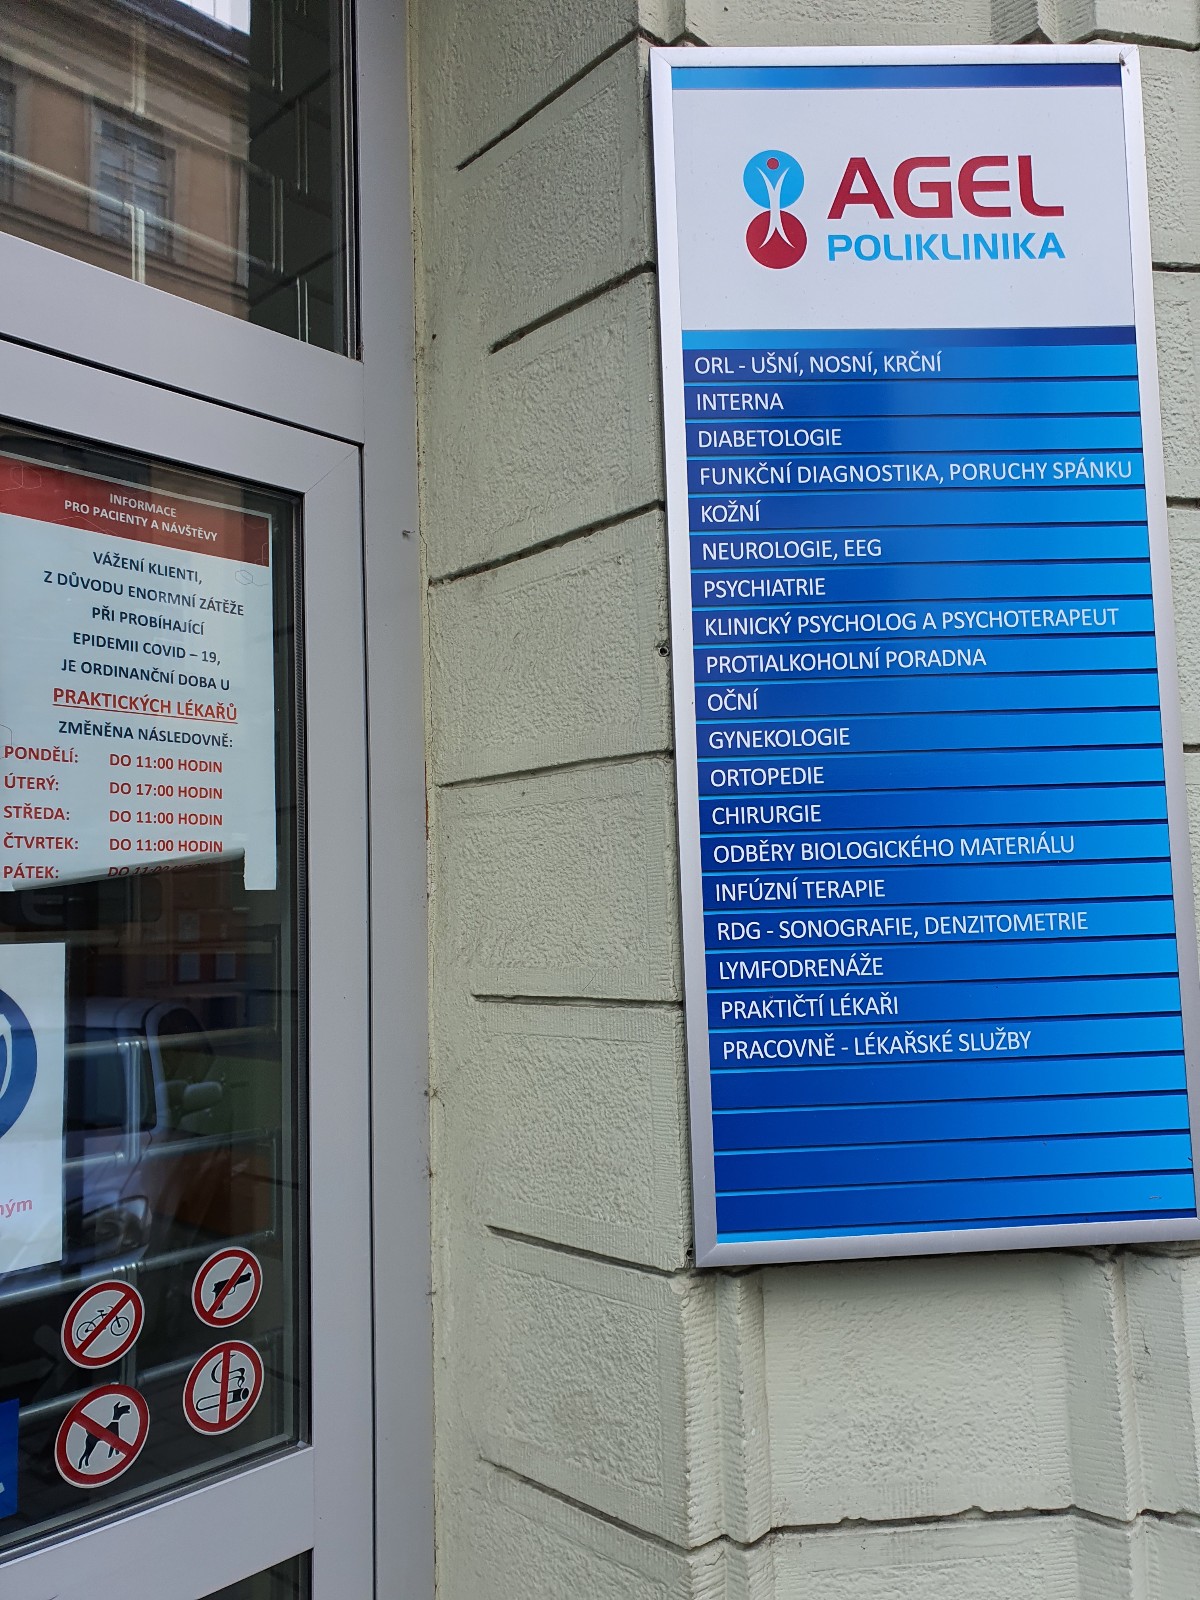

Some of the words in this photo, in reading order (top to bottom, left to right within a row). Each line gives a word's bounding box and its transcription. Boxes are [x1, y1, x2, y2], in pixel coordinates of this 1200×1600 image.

[827, 154, 1064, 220] AGEL
[828, 232, 1065, 261] POLIKLINIKA
[694, 356, 734, 376] ORL
[752, 350, 804, 377] UŠNÍ,
[809, 351, 878, 376] NOSNÍ,
[883, 350, 942, 374] KRČNÍ
[697, 392, 784, 412] INTERNA
[698, 428, 842, 448] DIABETOLOGIE
[700, 462, 792, 486] FUNKČNÍ
[798, 464, 944, 485] DIAGNOSTIKA,
[950, 462, 1048, 482] PORUCHY
[1053, 456, 1132, 480] SPÁNKU
[110, 494, 176, 518] INFORMACE
[701, 500, 760, 524] KOŽNÍ
[64, 500, 90, 514] PRO
[93, 506, 148, 528] PACIENTY
[150, 520, 159, 529] A
[162, 520, 218, 542] NÁVŠTĚVY
[702, 540, 838, 561] NEUROLOGIE,
[844, 538, 882, 558] EEG
[92, 552, 144, 572] VÁŽENÍ
[149, 562, 202, 585] KLIENTI,
[44, 571, 52, 584] Z
[57, 572, 124, 596] DŮVODU
[128, 586, 196, 608] ENORMNÍ
[199, 598, 244, 616] ZÁTĚŽE
[704, 578, 826, 598] PSYCHIATRIE
[92, 606, 115, 622] PŘI
[120, 612, 204, 635] PROBÍHAJÍCÍ
[705, 611, 792, 636] KLINICKÝ
[798, 612, 916, 633] PSYCHOLOG
[922, 611, 937, 630] A
[942, 608, 1119, 630] PSYCHOTERAPEUT
[74, 632, 138, 652] EPIDEMII
[143, 642, 186, 658] COVID
[202, 651, 221, 665] 19,
[706, 646, 880, 673] PROTIALKOHOLNÍ
[886, 649, 987, 669] PORADNA
[62, 658, 76, 672] JE
[81, 662, 174, 684] ORDINANČNÍ
[178, 674, 216, 689] DOBA
[221, 679, 230, 690] U
[54, 688, 170, 714] PRAKTICKÝCH
[177, 700, 237, 720] LÉKAŘŮ
[707, 688, 758, 712] OČNÍ
[58, 720, 133, 739] ZMĚNĚNA
[138, 727, 233, 748] NÁSLEDOVNĚ:
[708, 728, 850, 750] GYNEKOLOGIE
[4, 745, 78, 763] PONDĚLÍ:
[109, 754, 131, 766] DO
[136, 756, 174, 769] 11:00
[178, 760, 222, 773] HODIN
[4, 772, 58, 791] ÚTERÝ:
[109, 782, 131, 794] DO
[136, 784, 174, 796] 17:00
[178, 786, 222, 799] HODIN
[710, 766, 824, 787] ORTOPEDIE
[4, 803, 70, 820] STŘEDA:
[109, 810, 131, 822] DO
[136, 811, 174, 824] 11:00
[178, 814, 222, 826] HODIN
[712, 804, 822, 825] CHIRURGIE
[3, 832, 78, 850] ČTVRTEK:
[109, 838, 131, 850] DO
[136, 839, 174, 852] 11:00
[178, 841, 222, 853] HODIN
[714, 839, 795, 864] ODBĚRY
[801, 835, 954, 861] BIOLOGICKÉHO
[960, 831, 1075, 857] MATERIÁLU
[3, 863, 58, 878] PÁTEK:
[716, 877, 798, 902] INFÚZNÍ
[802, 880, 885, 899] TERAPIE
[717, 921, 760, 941] RDG
[778, 917, 918, 939] SONOGRAFIE,
[924, 912, 1088, 936] DENZITOMETRIE
[719, 952, 883, 980] LYMFODRENÁŽE
[721, 994, 824, 1019] PRAKTIČTÍ
[830, 992, 898, 1016] LÉKAŘI
[723, 1033, 835, 1060] PRACOVNĚ
[854, 1029, 953, 1056] LÉKAŘSKÉ
[958, 1027, 1032, 1053] SLUŽBY
